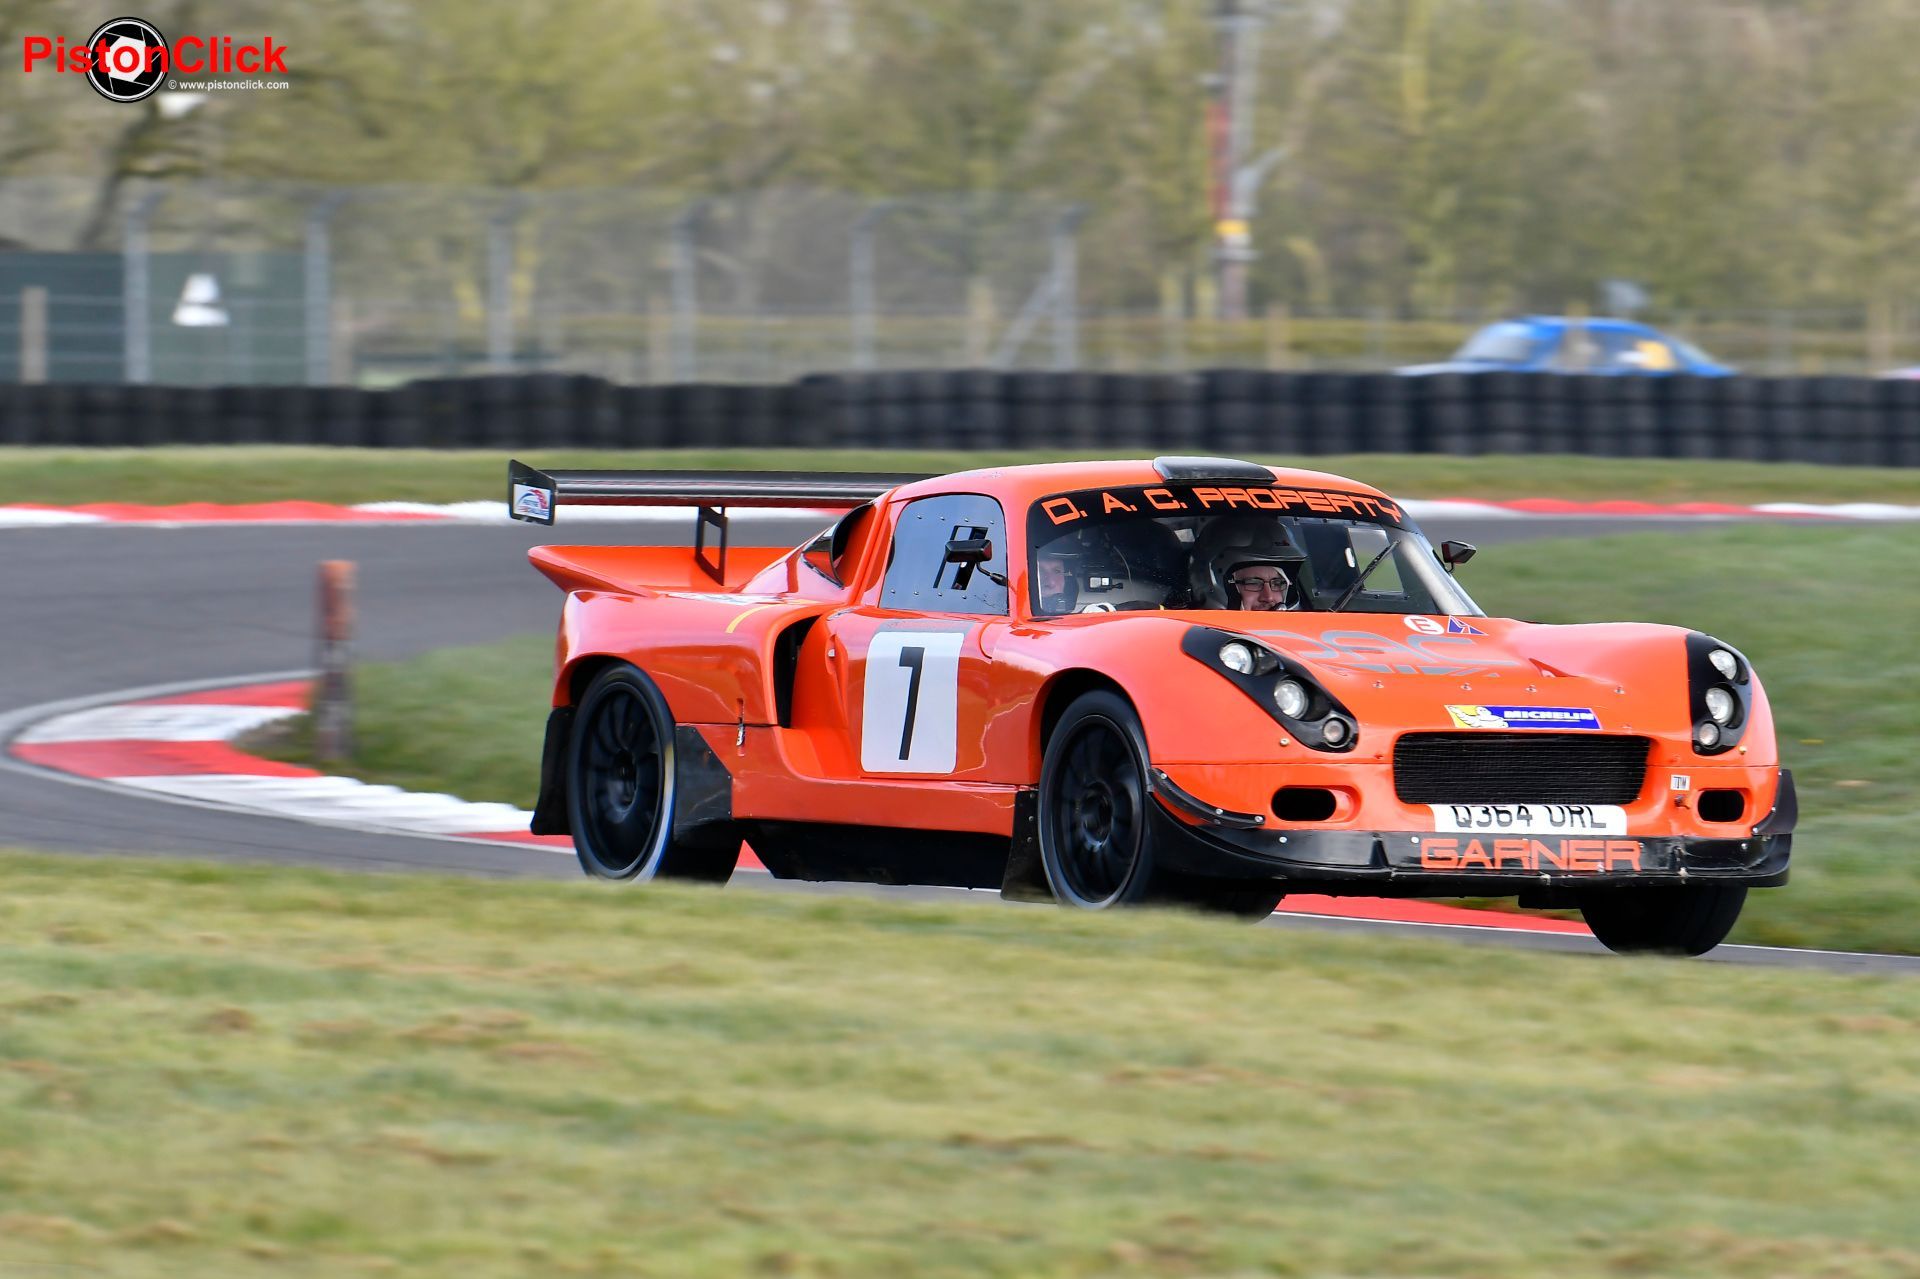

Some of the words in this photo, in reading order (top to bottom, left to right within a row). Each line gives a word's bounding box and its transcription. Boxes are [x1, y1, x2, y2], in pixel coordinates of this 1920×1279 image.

[1042, 498, 1087, 525] D.
[1102, 492, 1137, 514] A.
[1143, 489, 1186, 510] C.
[1192, 487, 1401, 523] PROPERTY
[1504, 711, 1594, 720] MICHELIN
[1450, 806, 1533, 828] Q364
[1544, 806, 1607, 829] URL
[1421, 839, 1641, 871] GARNER
